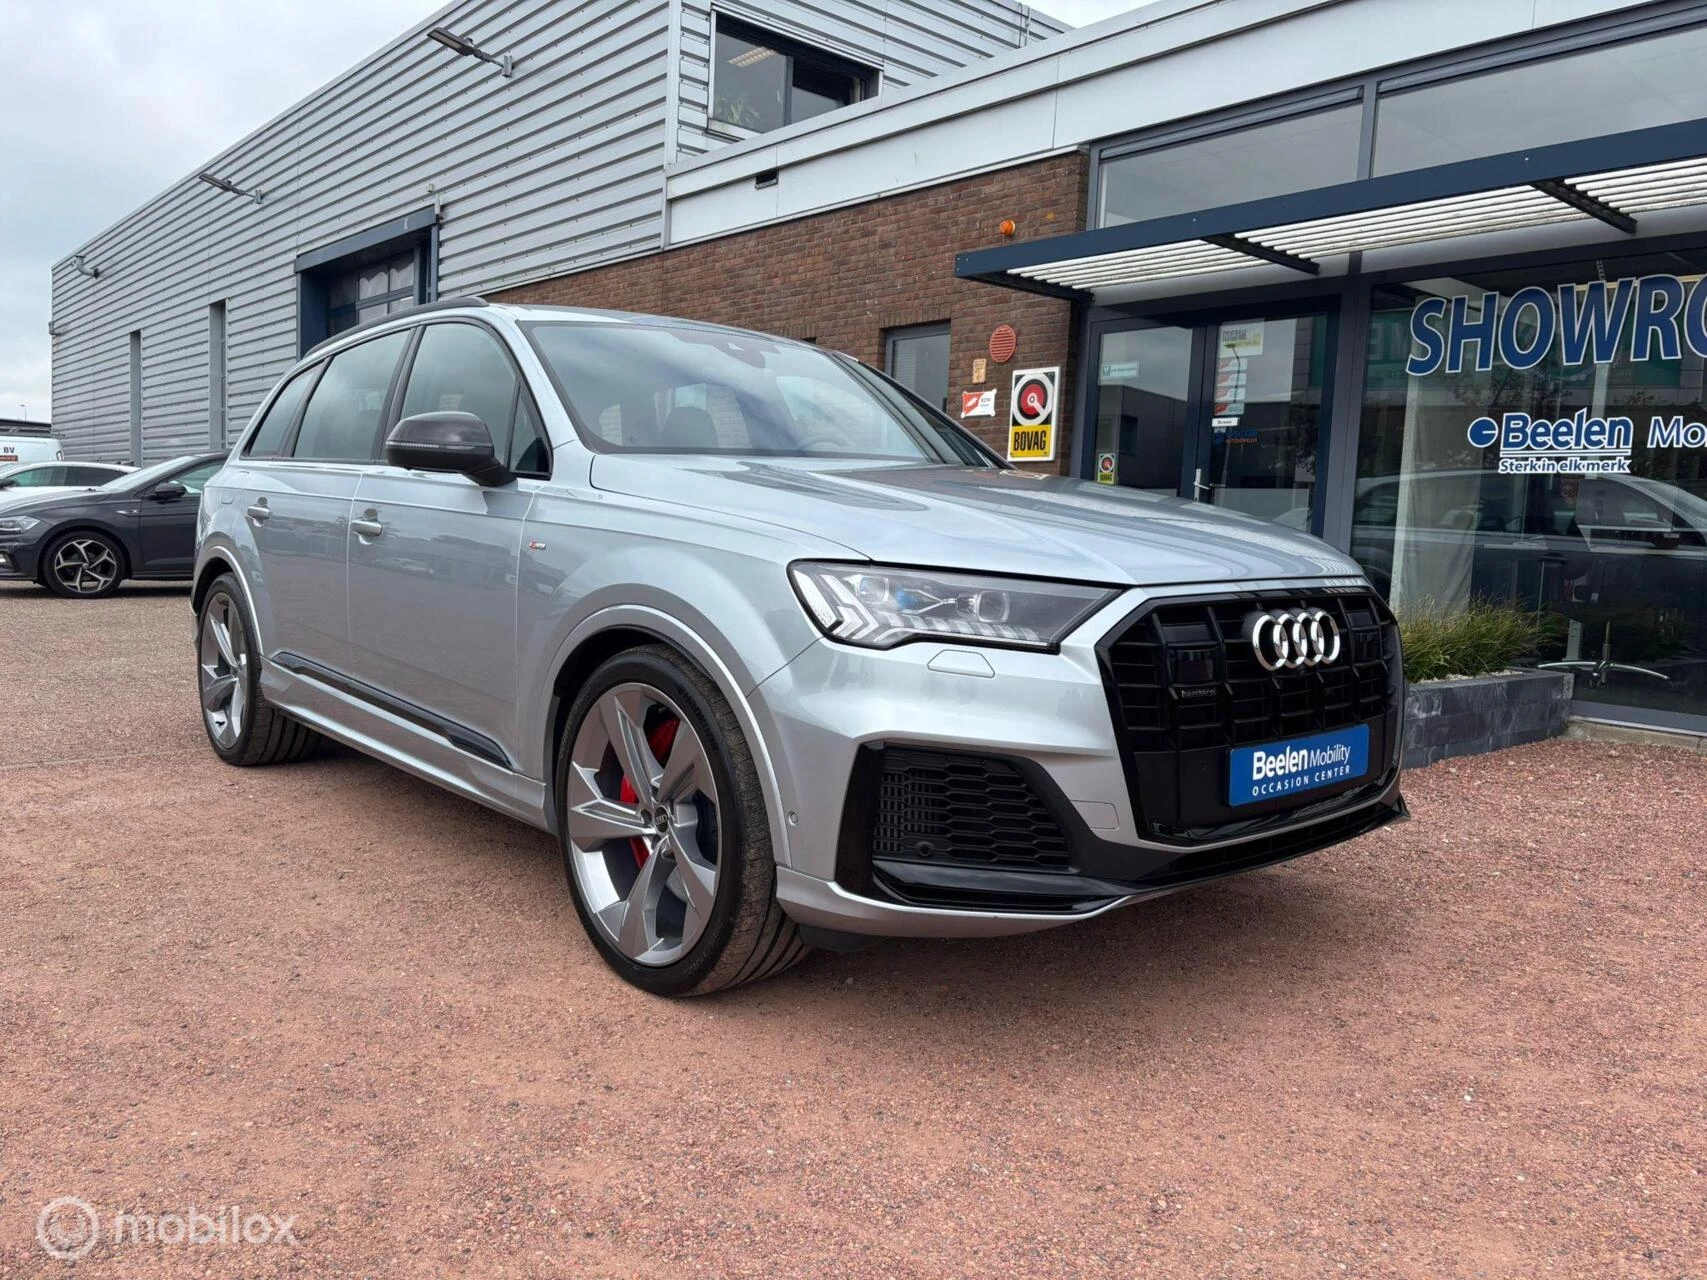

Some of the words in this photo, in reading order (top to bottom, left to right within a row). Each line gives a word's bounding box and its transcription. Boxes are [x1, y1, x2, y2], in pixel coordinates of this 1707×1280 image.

[1013, 430, 1047, 452] BOVAG
[1500, 407, 1633, 450] Beelen
[1647, 415, 1707, 448] Mo
[3, 446, 15, 454] BV
[1499, 458, 1539, 472] Sterk
[1541, 459, 1556, 472] in
[1559, 458, 1584, 472] elk
[1586, 458, 1628, 472] merk
[1252, 746, 1308, 780] Beelen
[1309, 744, 1351, 767] Mobility
[1252, 775, 1309, 796] OCCASION
[1314, 765, 1350, 782] CENTER
